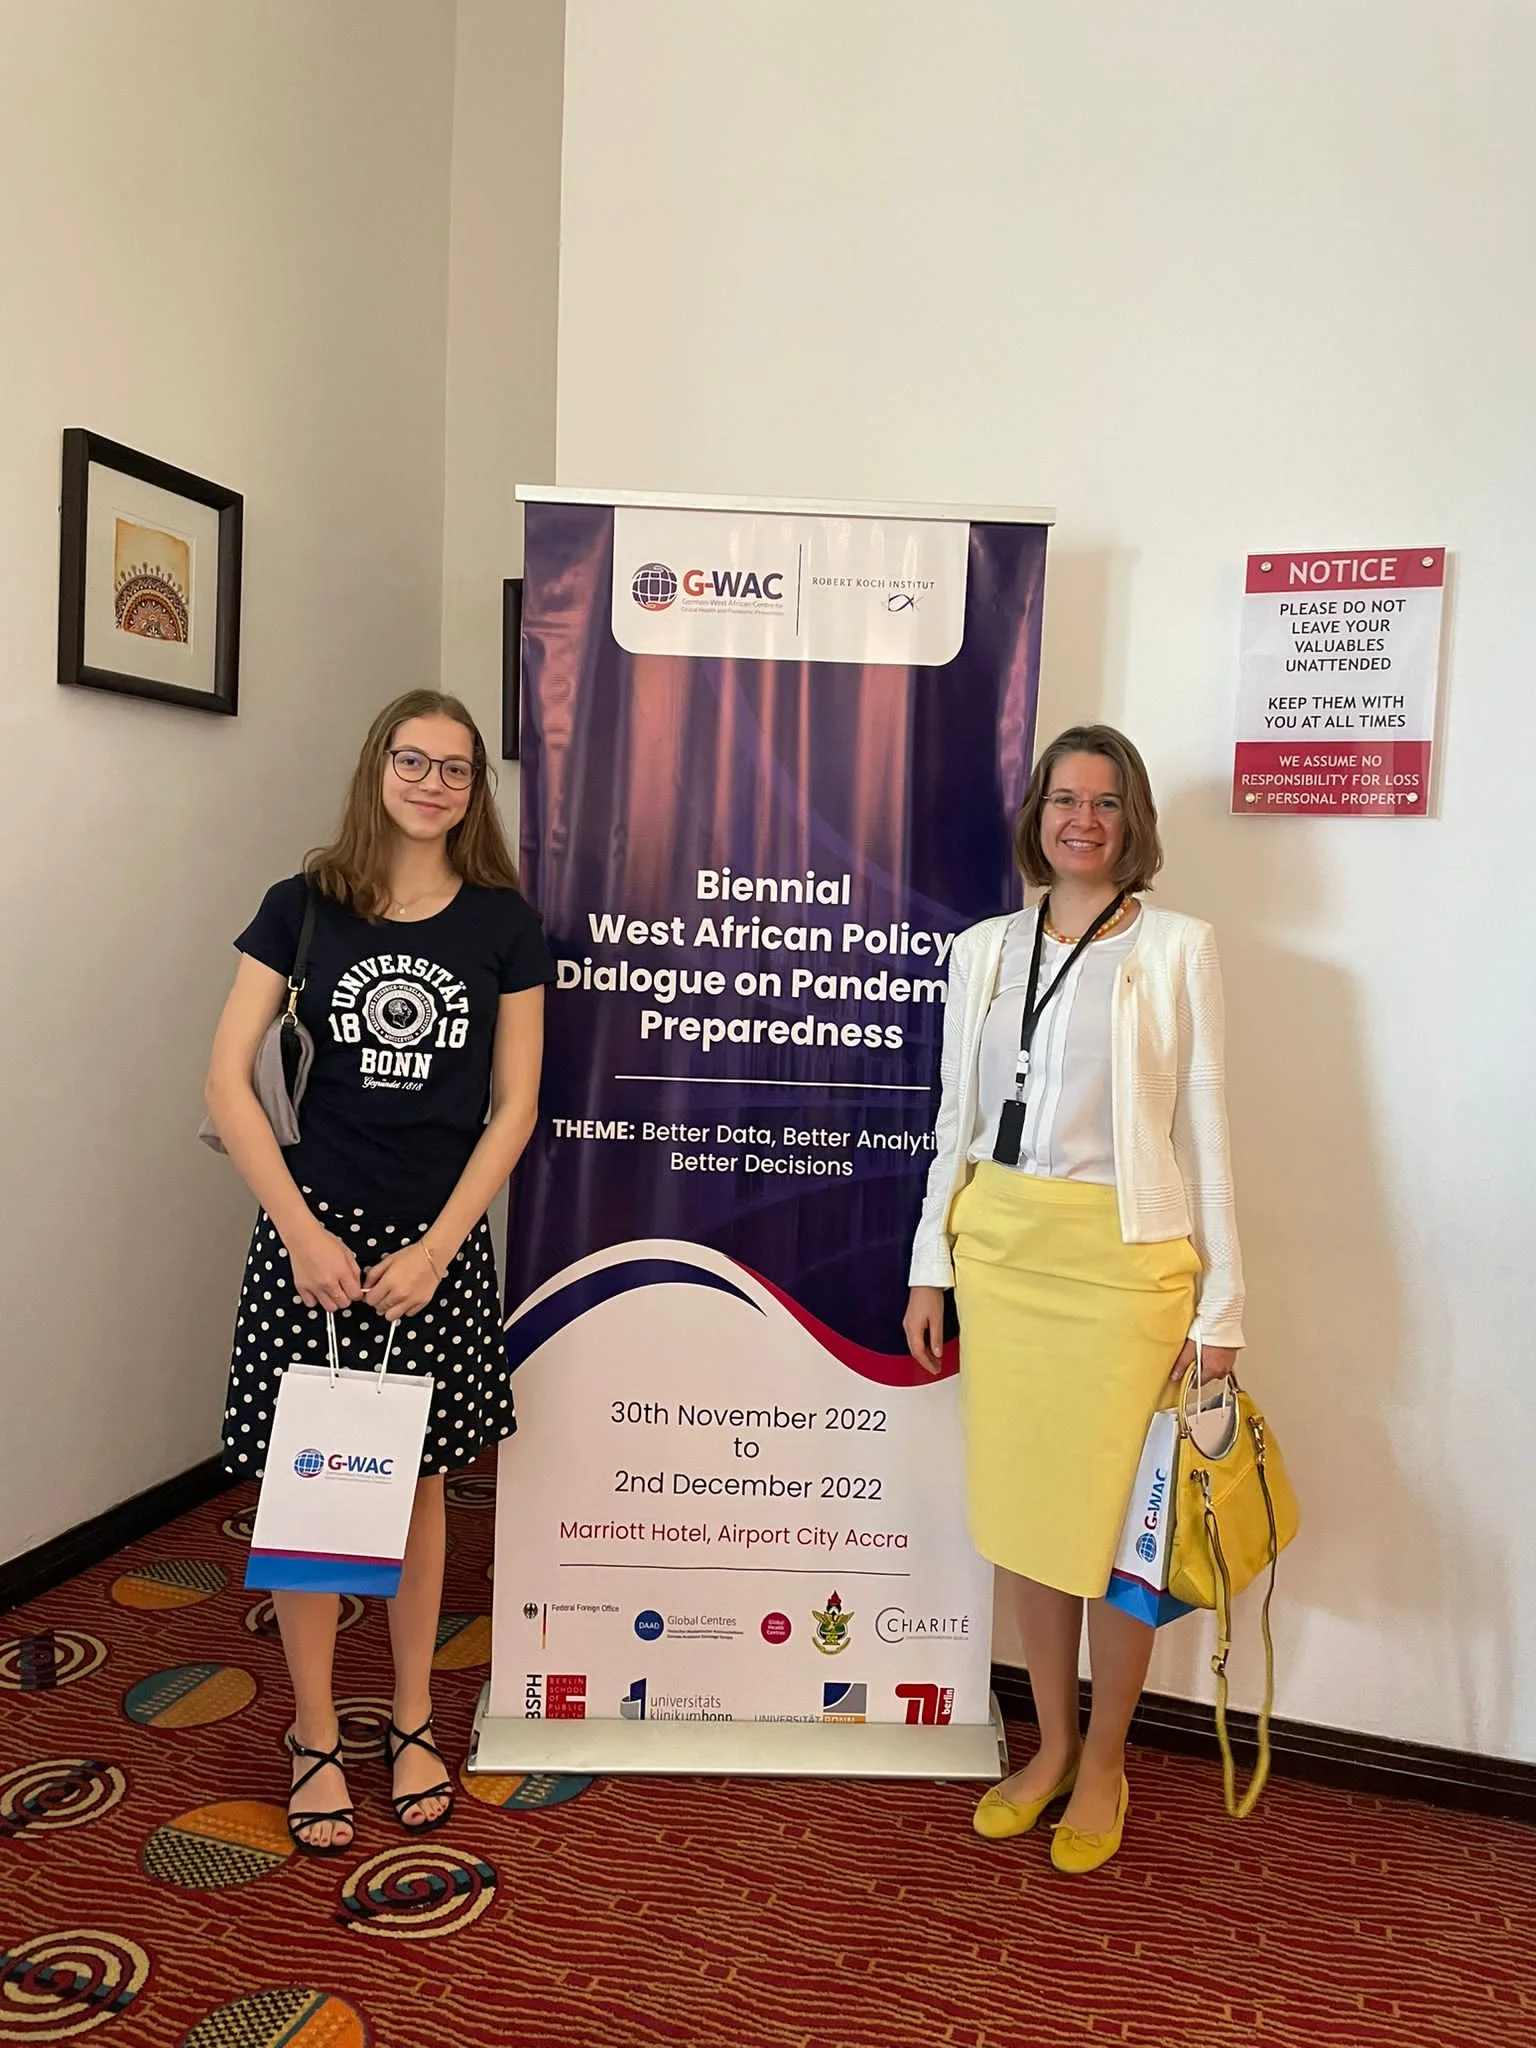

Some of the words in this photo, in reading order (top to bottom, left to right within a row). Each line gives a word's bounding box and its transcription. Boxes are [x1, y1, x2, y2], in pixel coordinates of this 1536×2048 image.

[812, 576, 853, 587] ROBERT
[856, 578, 885, 588] KOCH
[888, 580, 935, 590] INSTITUT
[1289, 557, 1398, 585] NOTICE
[682, 569, 784, 600] G-WAC
[1279, 601, 1337, 616] PLEASE
[1343, 601, 1366, 614] DO
[1371, 599, 1407, 613] NOT
[1292, 620, 1340, 634] LEAVE
[1345, 619, 1391, 633] YOUR
[1295, 638, 1385, 653] VALUABLES
[1286, 658, 1392, 672] UNATTENDED
[1268, 696, 1307, 710] KEEP
[1311, 696, 1357, 709] THEM
[1361, 695, 1404, 709] WITH
[1264, 716, 1297, 729] YOU
[1300, 715, 1321, 729] AT
[1324, 715, 1355, 728] ALL
[1359, 714, 1406, 728] TIMES
[1279, 755, 1300, 767] WE
[1303, 755, 1357, 767] ASSUME
[1361, 755, 1382, 767] NO
[1241, 774, 1348, 786] RESPONSIBILITY
[1352, 774, 1380, 786] FOR
[1385, 774, 1420, 786] LOSS
[1267, 792, 1337, 805] PERSONAL
[696, 866, 852, 905] Biennial
[587, 912, 685, 946] West
[693, 915, 833, 952] African
[842, 921, 955, 966] Policy
[331, 953, 470, 1014] UNIVERSITÄT
[556, 957, 726, 1002] Dialogue
[734, 972, 782, 998] on
[791, 968, 947, 1003] Pandem
[328, 1012, 362, 1043] 18
[434, 1017, 470, 1049] 18
[640, 1009, 904, 1052] Preparedness
[359, 1047, 433, 1080] BONN
[552, 1118, 636, 1141] THEME:
[642, 1122, 711, 1143] Better
[716, 1125, 778, 1148] Data,
[783, 1127, 851, 1149] Better
[856, 1130, 936, 1155] Analyti
[670, 1152, 739, 1173] Better
[745, 1154, 853, 1177] Decisions
[610, 1401, 670, 1425] 30th
[678, 1404, 818, 1430] November
[824, 1407, 888, 1432] 2022
[733, 1437, 760, 1459] to
[327, 1454, 395, 1475] G-WAC
[614, 1470, 665, 1494] 2nd
[673, 1473, 814, 1499] December
[820, 1476, 883, 1501] 2022
[559, 1521, 646, 1541] Marriott
[652, 1523, 711, 1545] Hotel,
[718, 1525, 791, 1549] Airport
[796, 1527, 840, 1551] City
[844, 1529, 909, 1549] Accra
[551, 1603, 576, 1612] Federal
[576, 1604, 601, 1614] Foreign
[601, 1605, 620, 1613] Office
[667, 1615, 699, 1626] Global
[700, 1616, 737, 1627] Centres
[638, 1621, 660, 1630] DAAD
[886, 1615, 969, 1634] CHARITÉ
[525, 1674, 542, 1719] BSPH
[942, 1688, 953, 1715] berlin
